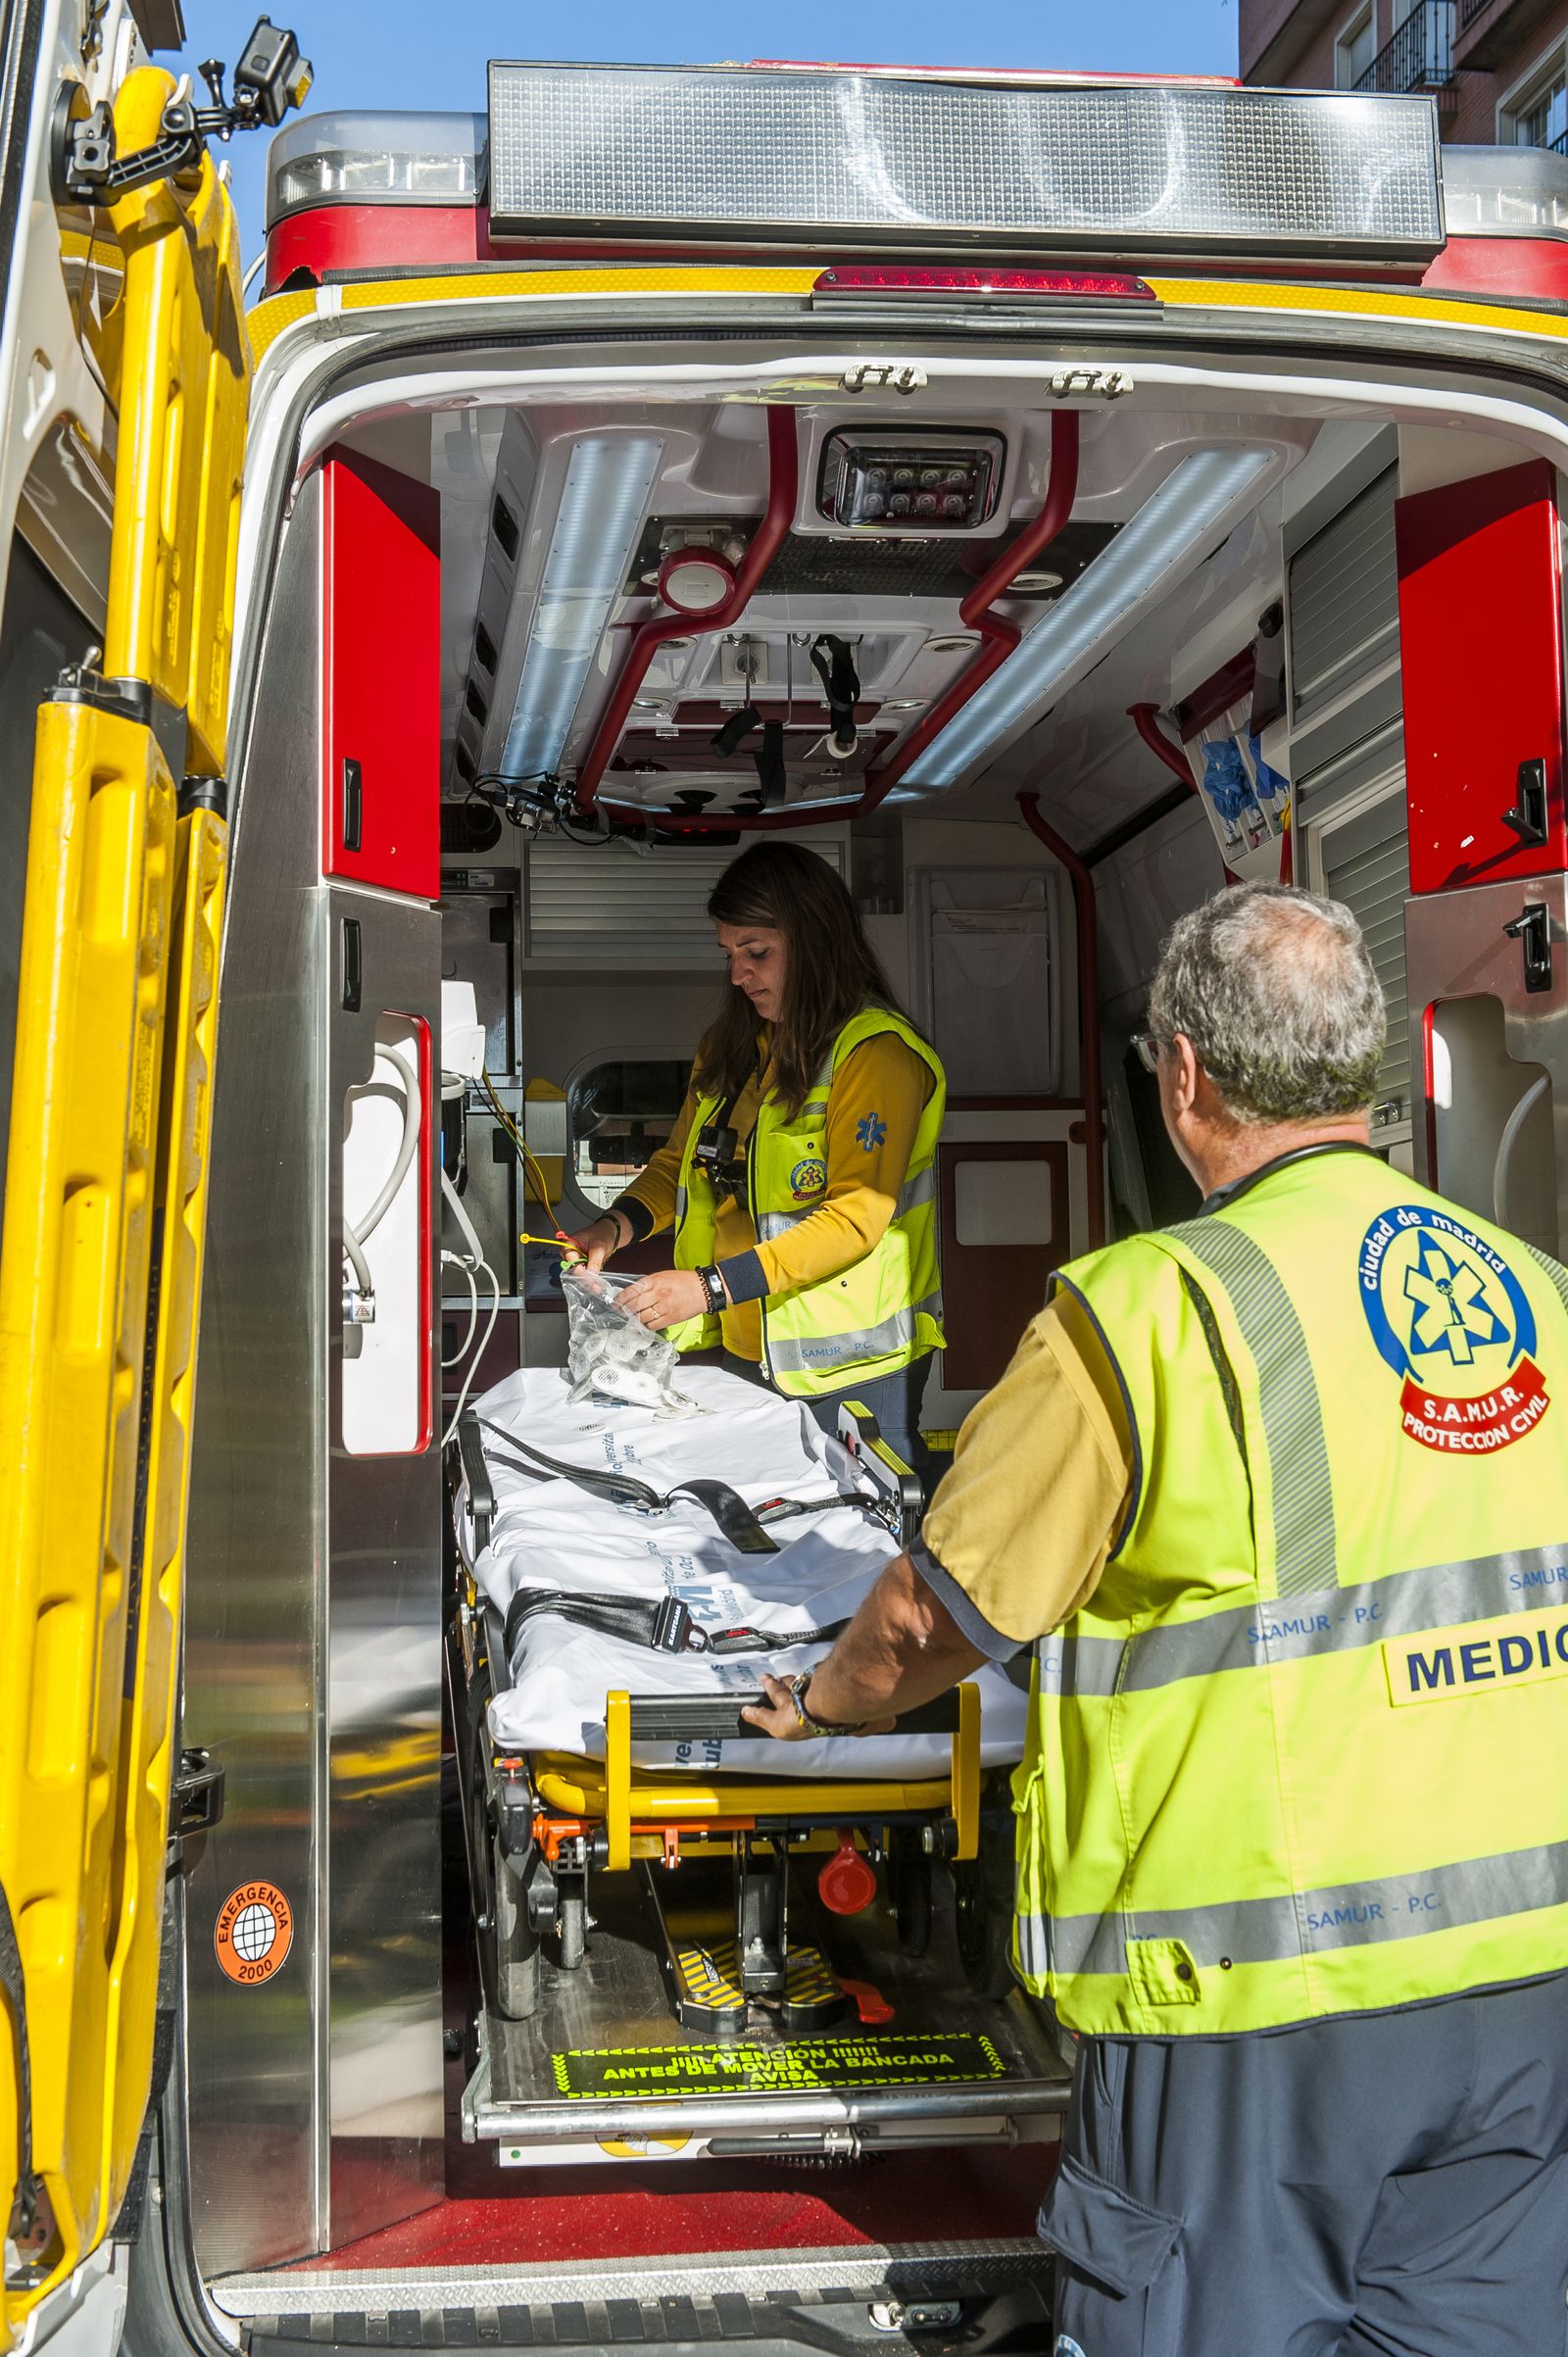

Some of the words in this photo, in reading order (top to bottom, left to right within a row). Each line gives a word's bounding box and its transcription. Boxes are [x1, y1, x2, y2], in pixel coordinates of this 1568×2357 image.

[1359, 1217, 1395, 1291] ciudad
[1396, 1207, 1422, 1227] de
[1431, 1213, 1506, 1274] madrid
[802, 1346, 842, 1358] SAMUR
[855, 1340, 874, 1351] P.C.
[1423, 1386, 1524, 1423] S.A.M.U.R.
[1403, 1413, 1510, 1449] PROTECCION
[1510, 1395, 1548, 1434] CIVIL
[1510, 1566, 1568, 1591] SAMUR
[219, 1887, 289, 1943] EMERGENCIA
[1306, 1903, 1385, 1931] SAMUR
[1408, 1892, 1443, 1914] P.C.
[238, 1959, 272, 1980] 2000
[603, 2065, 680, 2081] ANTES
[686, 2064, 717, 2077] DE
[723, 2060, 806, 2075] MOVER
[809, 2058, 840, 2070] LA
[845, 2053, 956, 2069] BANCADA
[750, 2070, 819, 2084] AVISA
